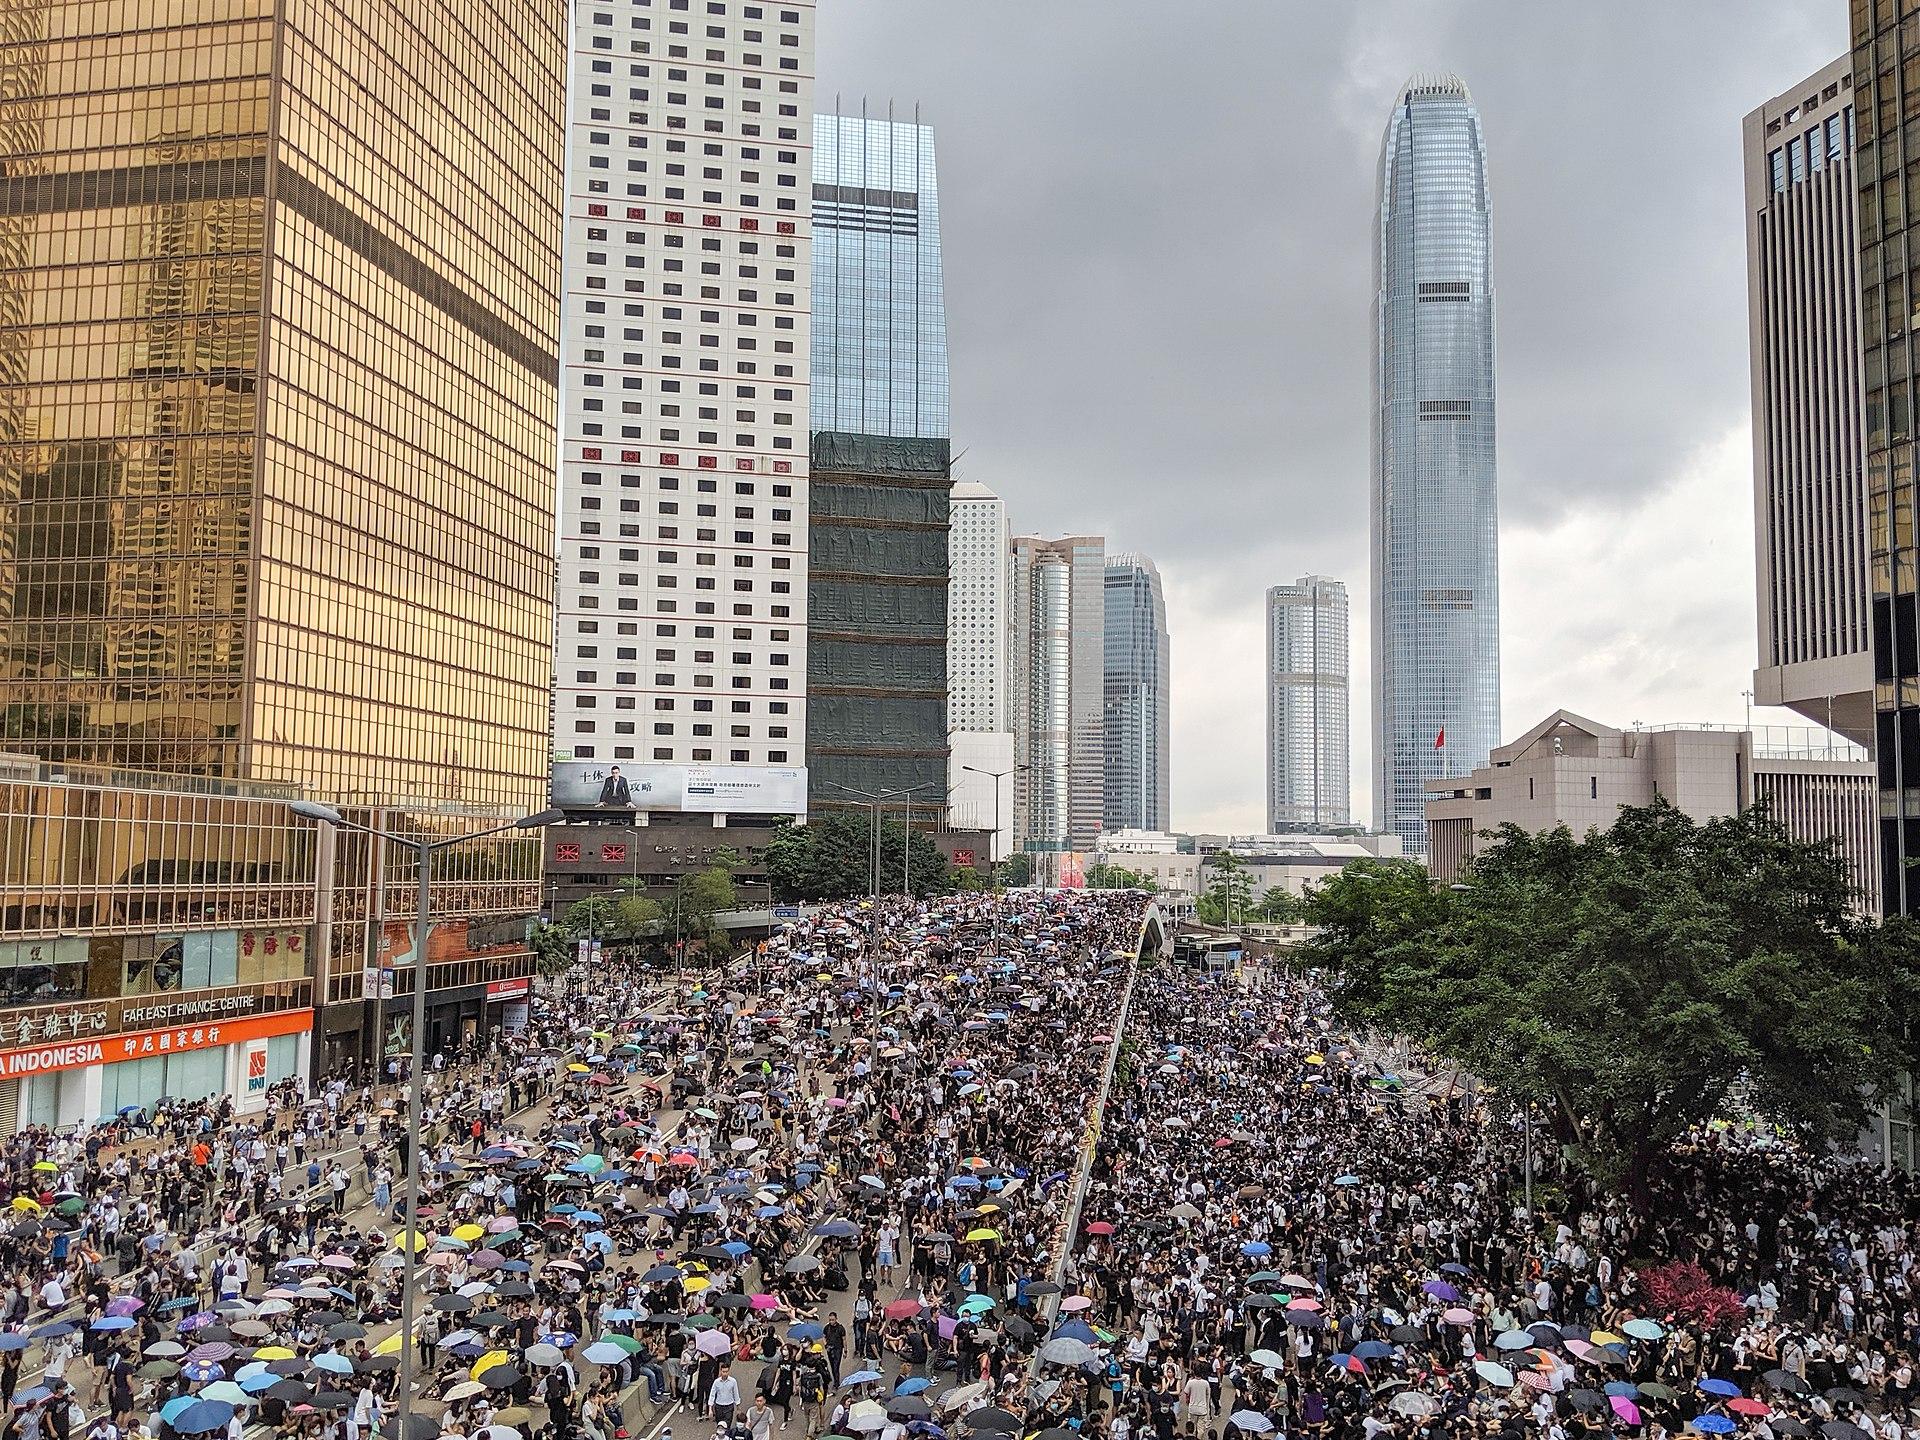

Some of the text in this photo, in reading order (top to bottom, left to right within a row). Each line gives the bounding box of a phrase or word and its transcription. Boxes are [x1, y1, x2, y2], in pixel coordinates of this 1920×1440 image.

[629, 781, 652, 792] 攻略
[123, 995, 255, 1023] FAR EAST FINANCE CENTRE
[124, 1027, 221, 1056] 印尼國家銀行
[9, 1043, 104, 1074] INDONESIA
[248, 1076, 265, 1091] BNI
